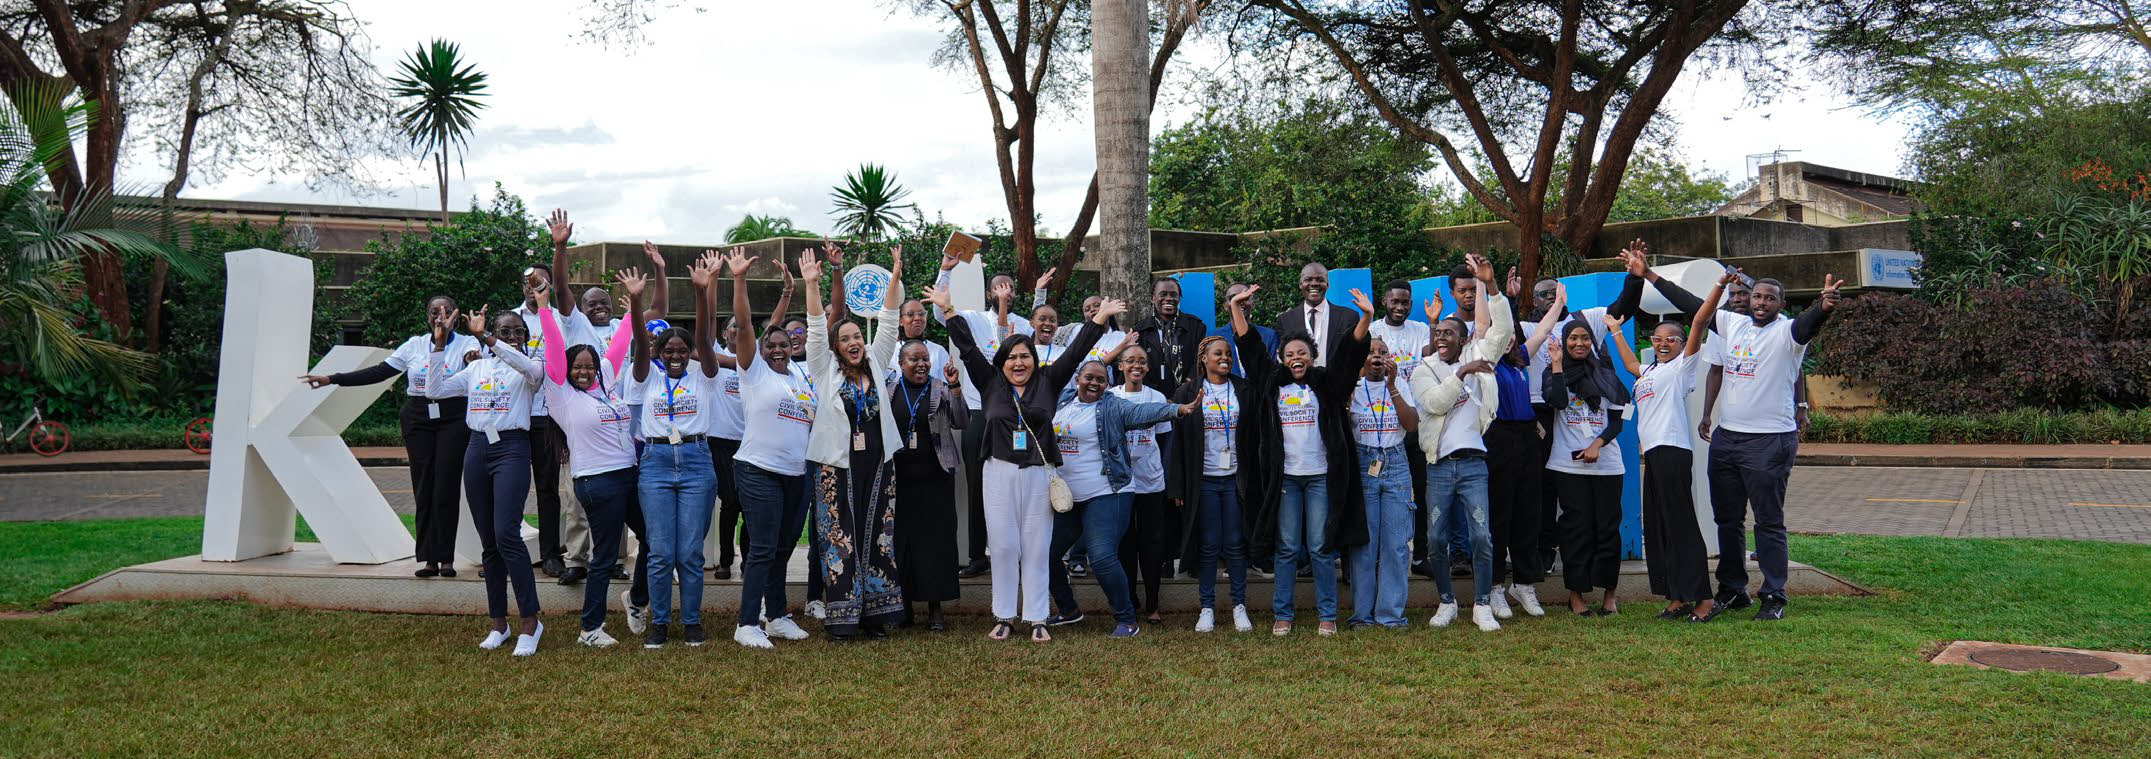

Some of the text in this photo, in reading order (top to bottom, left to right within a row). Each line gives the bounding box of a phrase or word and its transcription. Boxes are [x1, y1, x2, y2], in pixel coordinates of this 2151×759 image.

[653, 404, 698, 414] CONERENCE
[779, 401, 795, 411] CIVIL
[1359, 422, 1400, 430] CONFEENCE
